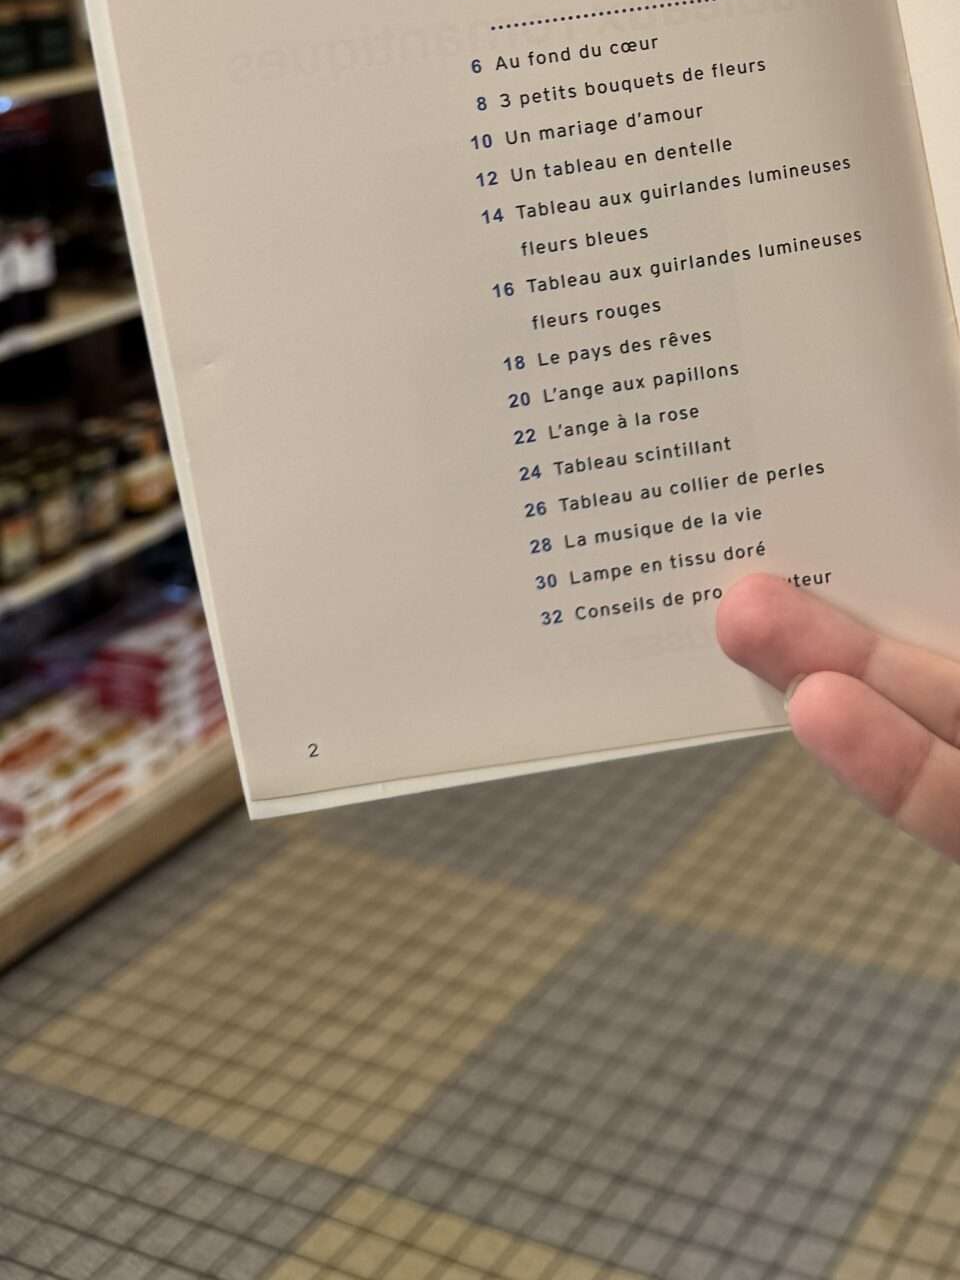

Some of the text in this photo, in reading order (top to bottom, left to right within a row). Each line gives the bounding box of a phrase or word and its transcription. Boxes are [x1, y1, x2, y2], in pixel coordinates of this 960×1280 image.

[471, 37, 659, 74] 6 Au fond du cœur
[477, 60, 766, 112] 8 3 petits bouquets de fleurs
[471, 106, 704, 150] 10 Un mariage d'amour
[476, 138, 733, 188] 12 Un tableau en dentelle
[481, 158, 851, 225] 14 Tableau aux guirlandes lumineuses
[492, 230, 862, 298] 16 Tableau aux guirlandes lumineuses
[521, 228, 649, 257] fleurs bleues
[532, 301, 662, 331] fleurs rouges
[504, 331, 712, 372] 18 Le pays des rêves
[508, 364, 740, 409] 20 L'ange aux papillons
[513, 407, 700, 445] 22 L'ange à la rose
[519, 436, 732, 482] 24 Tableau scintillant
[524, 463, 825, 518] 26 Tableau au collier de perles
[530, 507, 763, 555] 28 La musique de la vie
[535, 541, 766, 590] 30 Lampe en tissu doré
[541, 572, 832, 626] 32 Conseils de pro teur
[308, 743, 320, 758] 2
